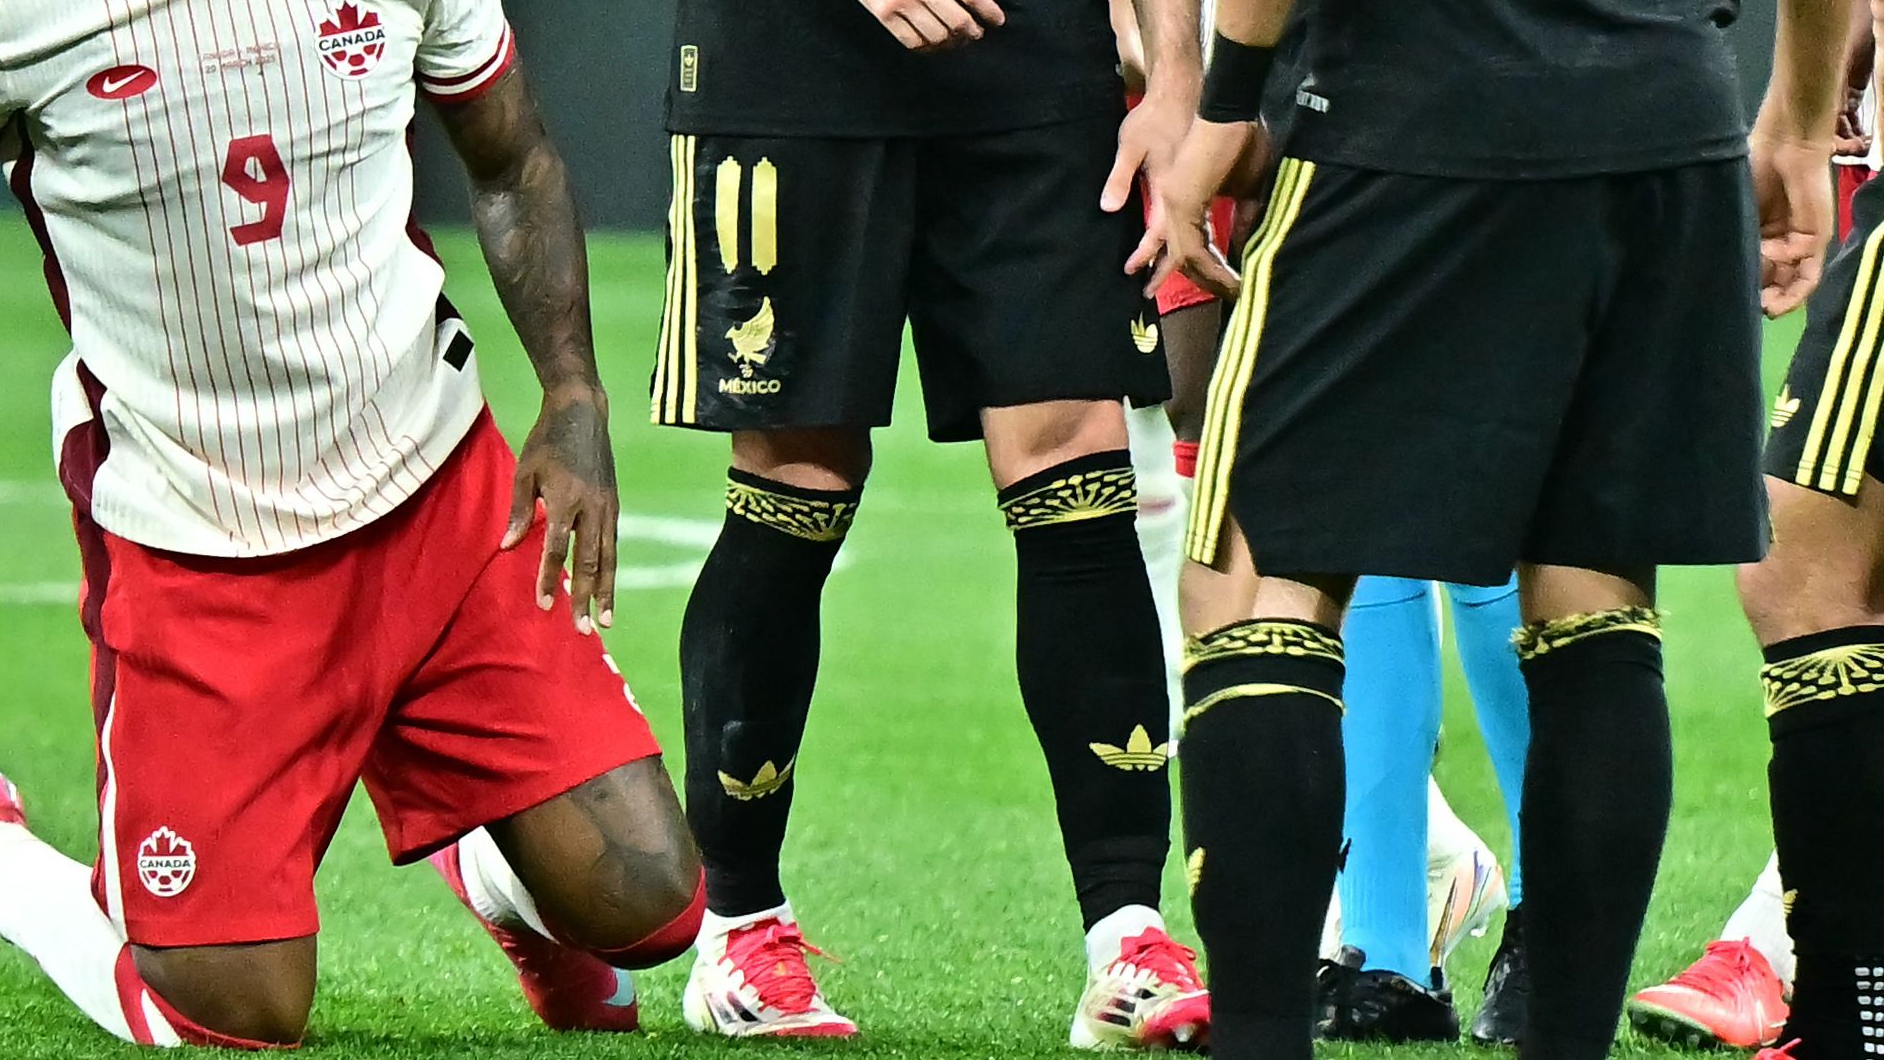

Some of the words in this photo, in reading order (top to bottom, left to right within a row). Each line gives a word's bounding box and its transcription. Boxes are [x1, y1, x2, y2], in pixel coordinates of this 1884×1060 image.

[318, 29, 386, 51] CANADA
[220, 133, 292, 247] 9
[715, 156, 778, 276] 11
[718, 377, 782, 395] MÉXICO
[139, 859, 192, 869] CANADA
